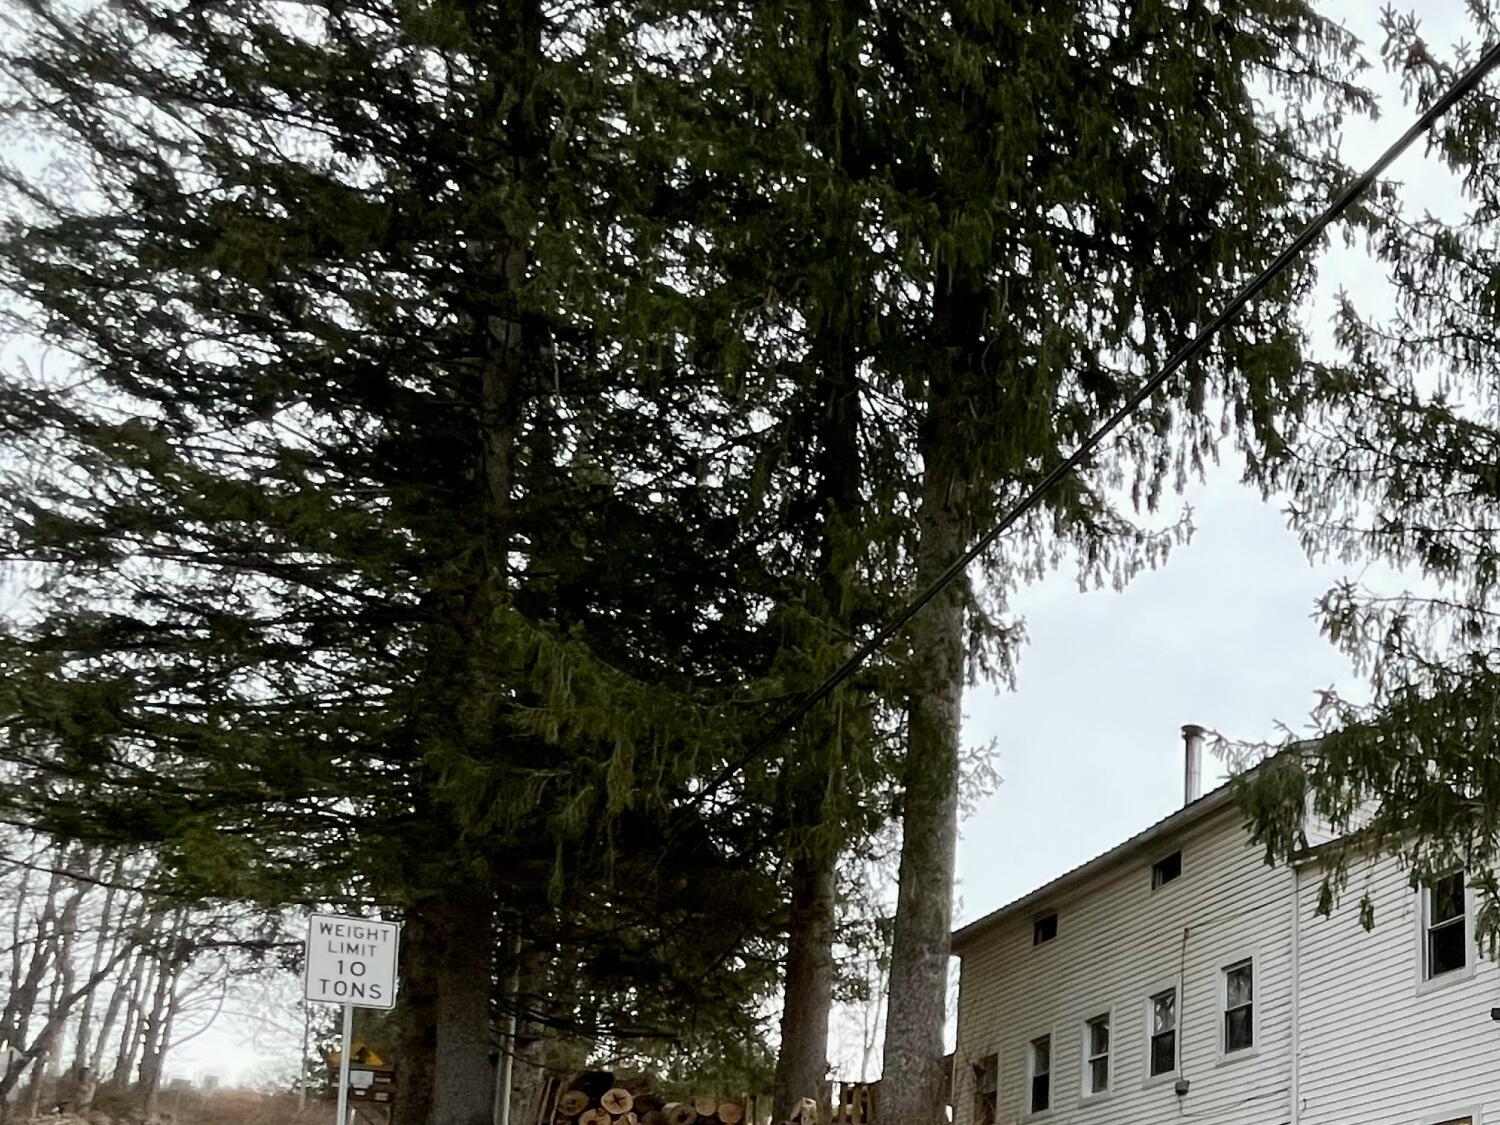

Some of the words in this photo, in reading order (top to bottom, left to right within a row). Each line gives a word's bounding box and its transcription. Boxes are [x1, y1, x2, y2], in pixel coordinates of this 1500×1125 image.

[319, 922, 390, 942] WEIGHT
[328, 940, 377, 957] LIMIT
[338, 960, 366, 977] 10
[319, 979, 382, 1000] TONS
